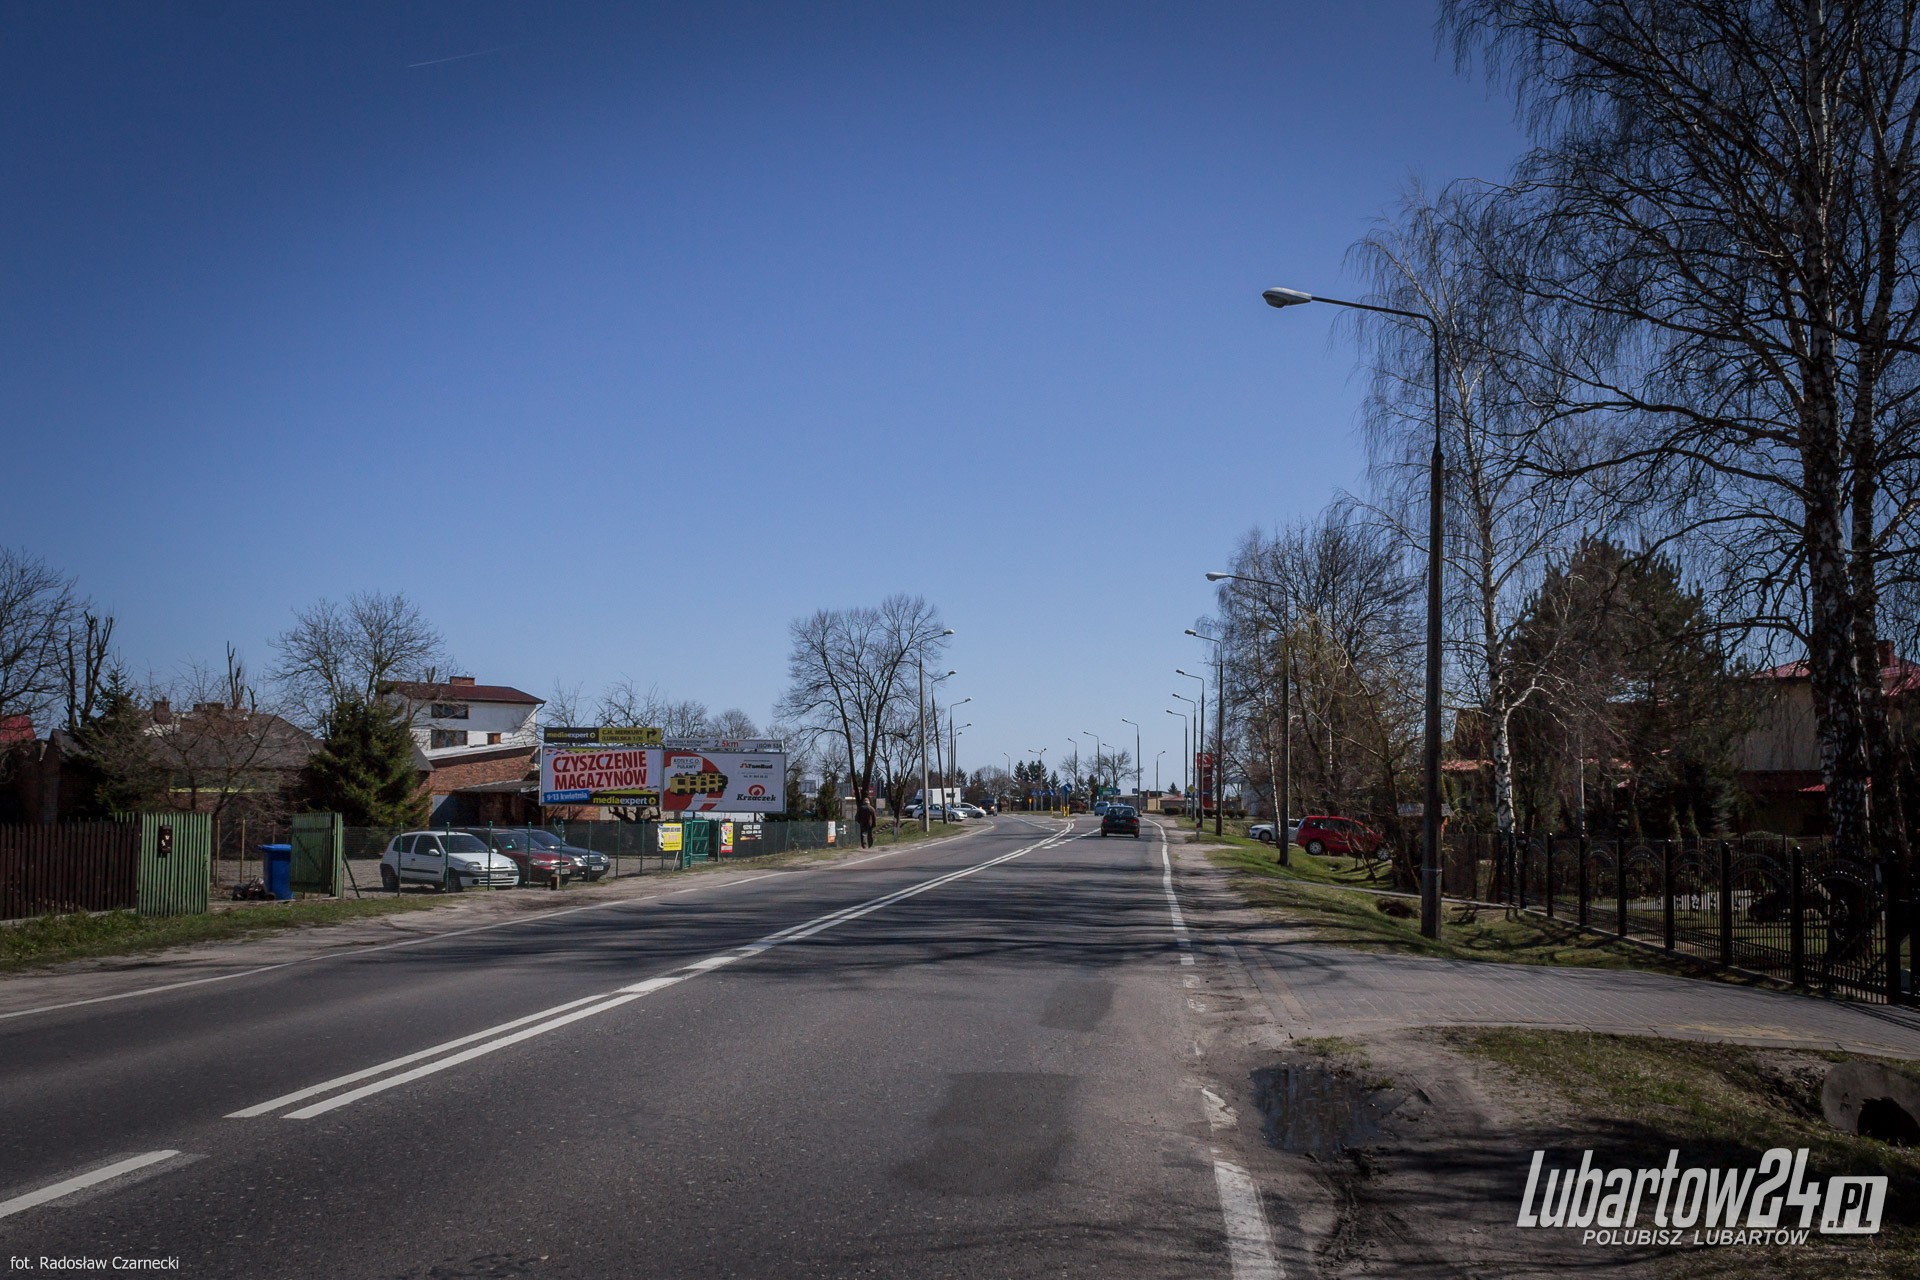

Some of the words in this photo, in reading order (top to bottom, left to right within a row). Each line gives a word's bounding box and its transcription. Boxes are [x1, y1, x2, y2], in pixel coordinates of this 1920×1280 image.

[553, 751, 647, 773] CZYSZCZENIE
[554, 768, 647, 790] MAGAZYNÓW
[546, 793, 560, 801] 9-13
[560, 791, 588, 800] kwietnia
[593, 796, 647, 805] mediaexpert
